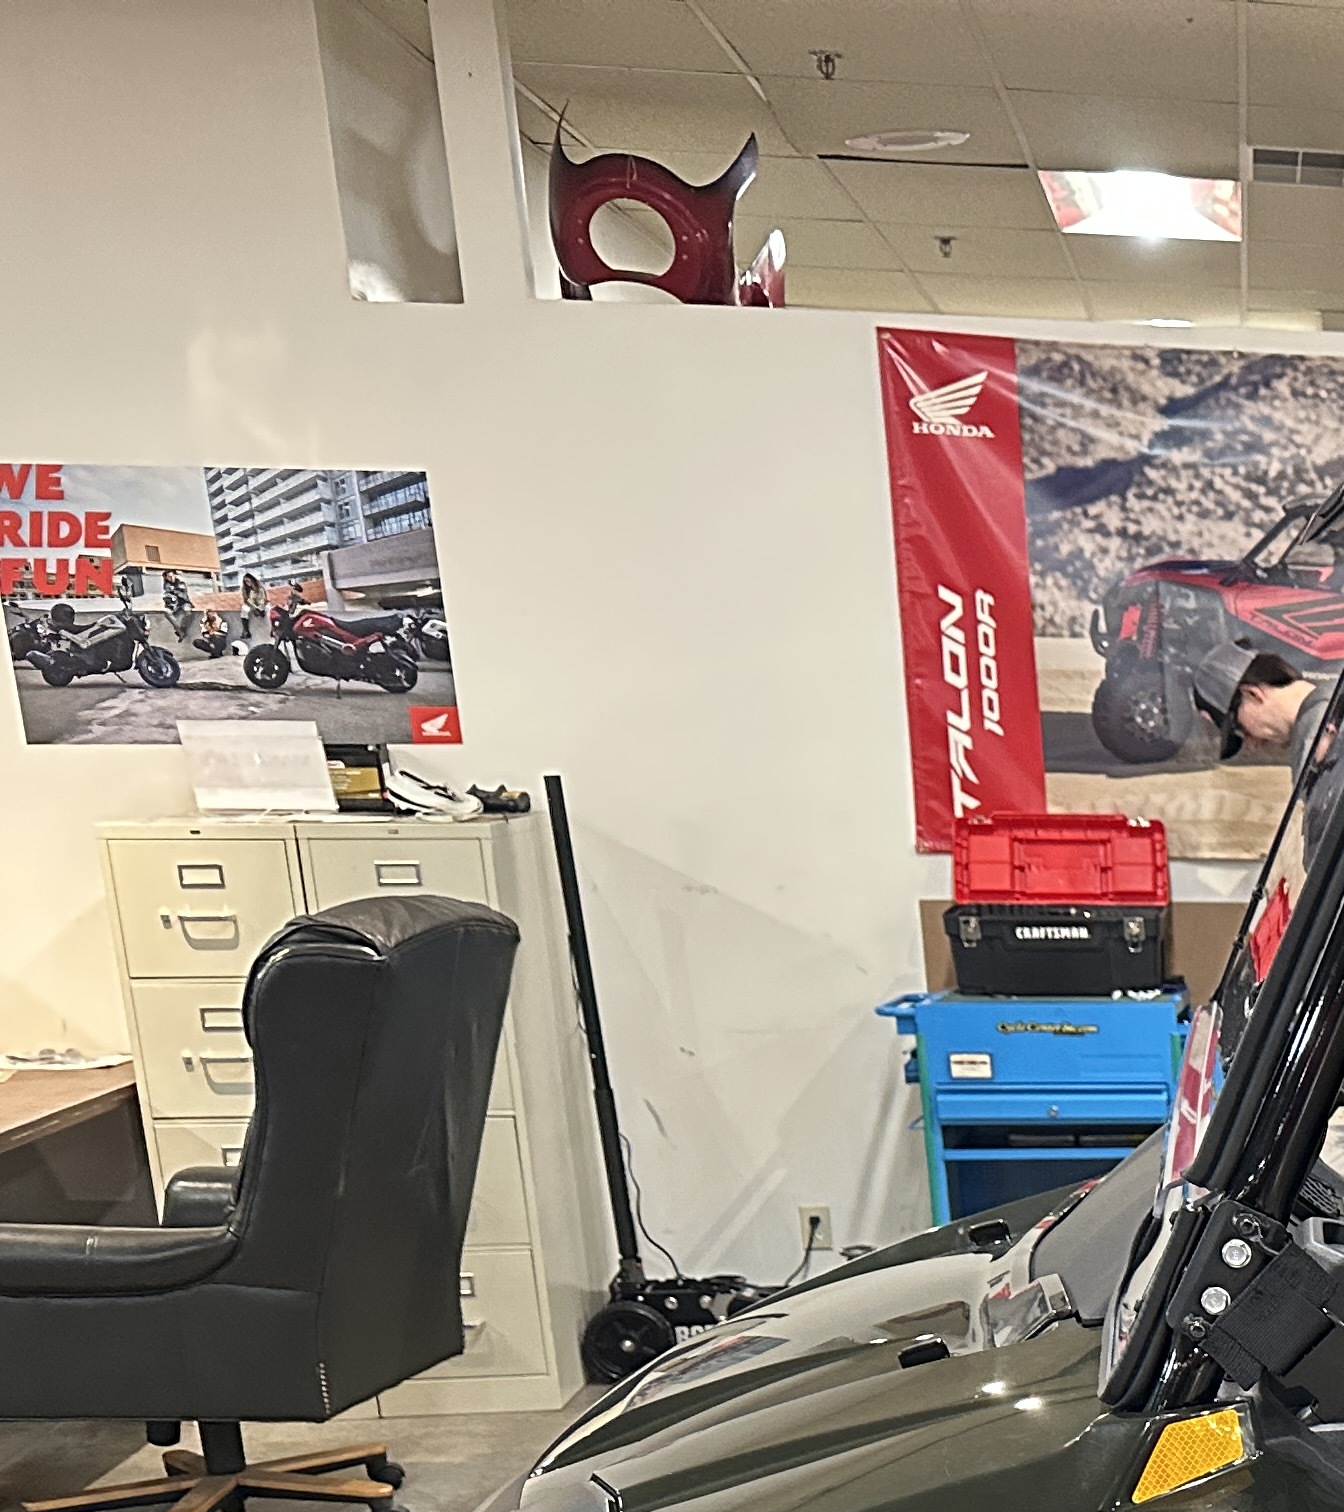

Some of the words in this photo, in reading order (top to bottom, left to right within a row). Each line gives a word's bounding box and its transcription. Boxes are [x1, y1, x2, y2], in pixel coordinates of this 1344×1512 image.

[911, 421, 996, 438] HONDA
[0, 464, 64, 499] WE
[0, 511, 112, 548] RIDE
[0, 558, 113, 596] FUN
[974, 588, 1004, 736] 1000R
[937, 584, 981, 818] TALON
